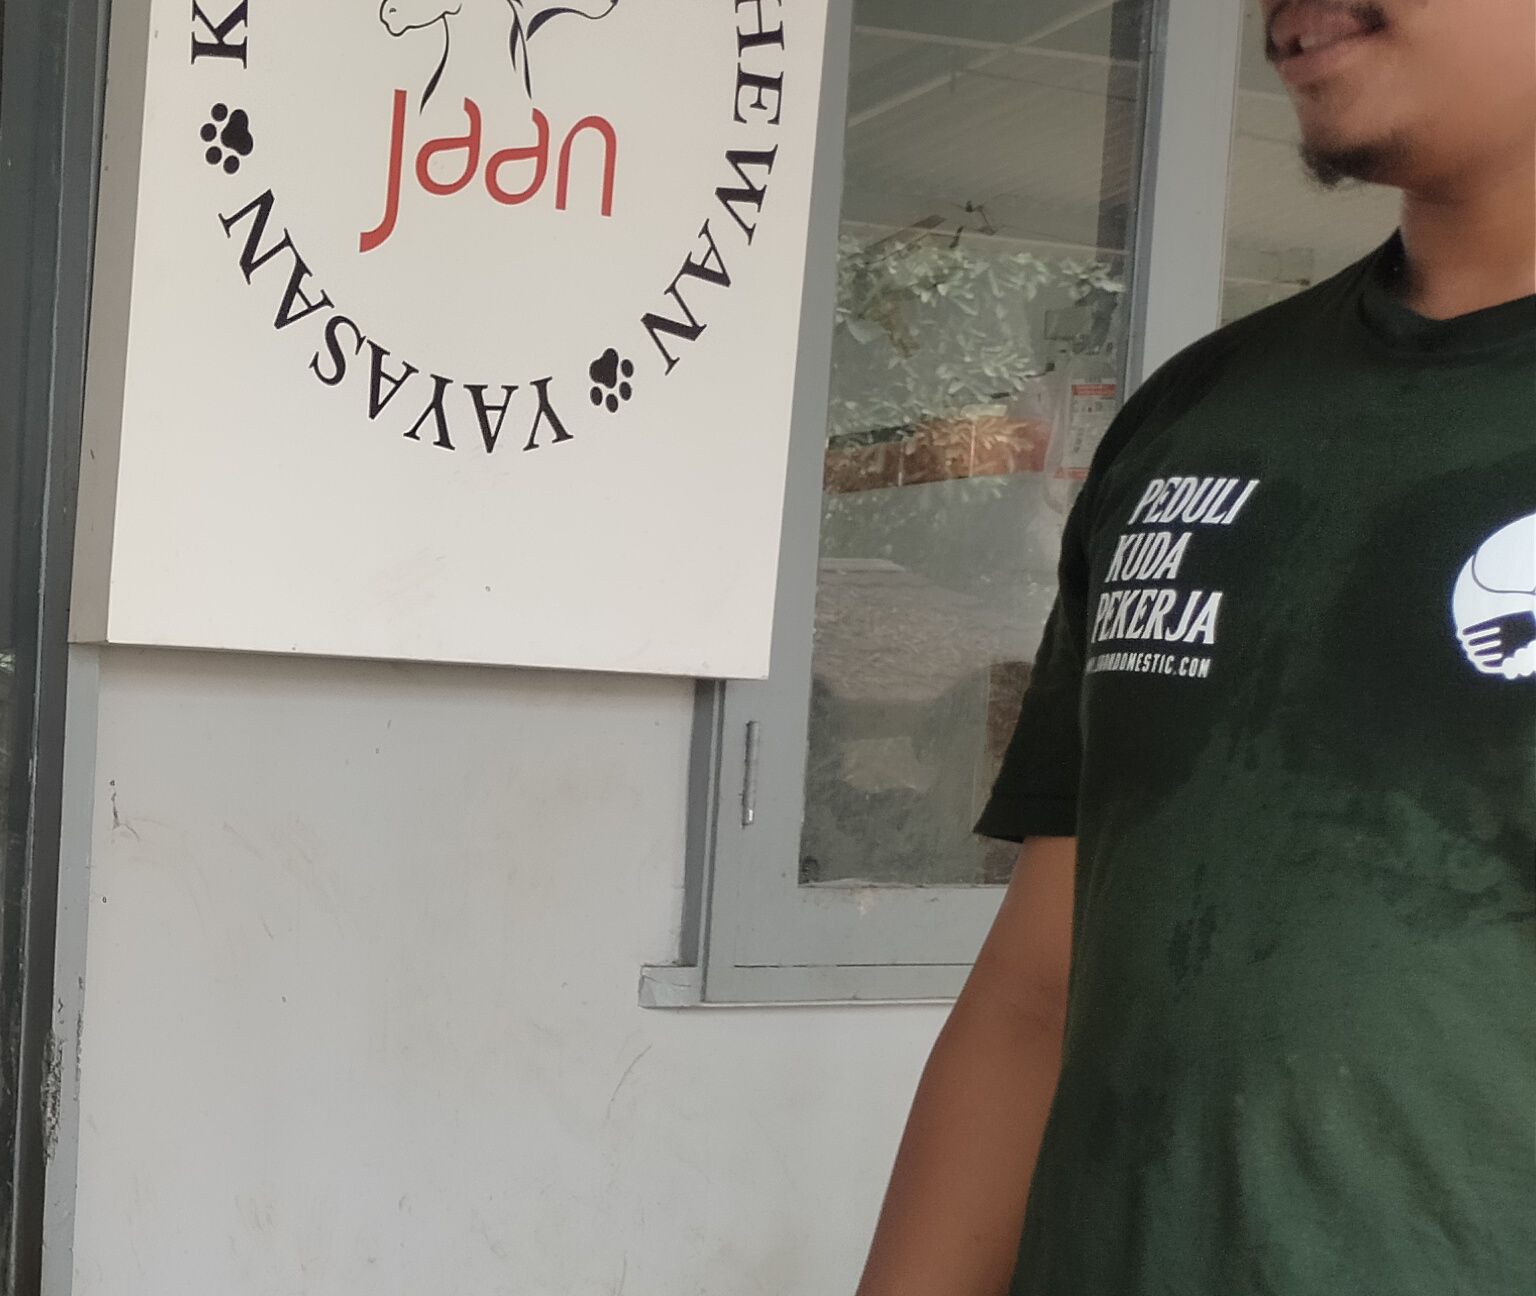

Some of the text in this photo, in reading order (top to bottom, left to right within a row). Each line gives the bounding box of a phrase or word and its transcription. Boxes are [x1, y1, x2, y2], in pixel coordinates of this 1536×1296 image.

[217, 189, 574, 453] YAYASAN
[1128, 476, 1260, 525] PEDULI
[1104, 531, 1192, 584] KUDA
[1091, 588, 1224, 645] PEKERJA
